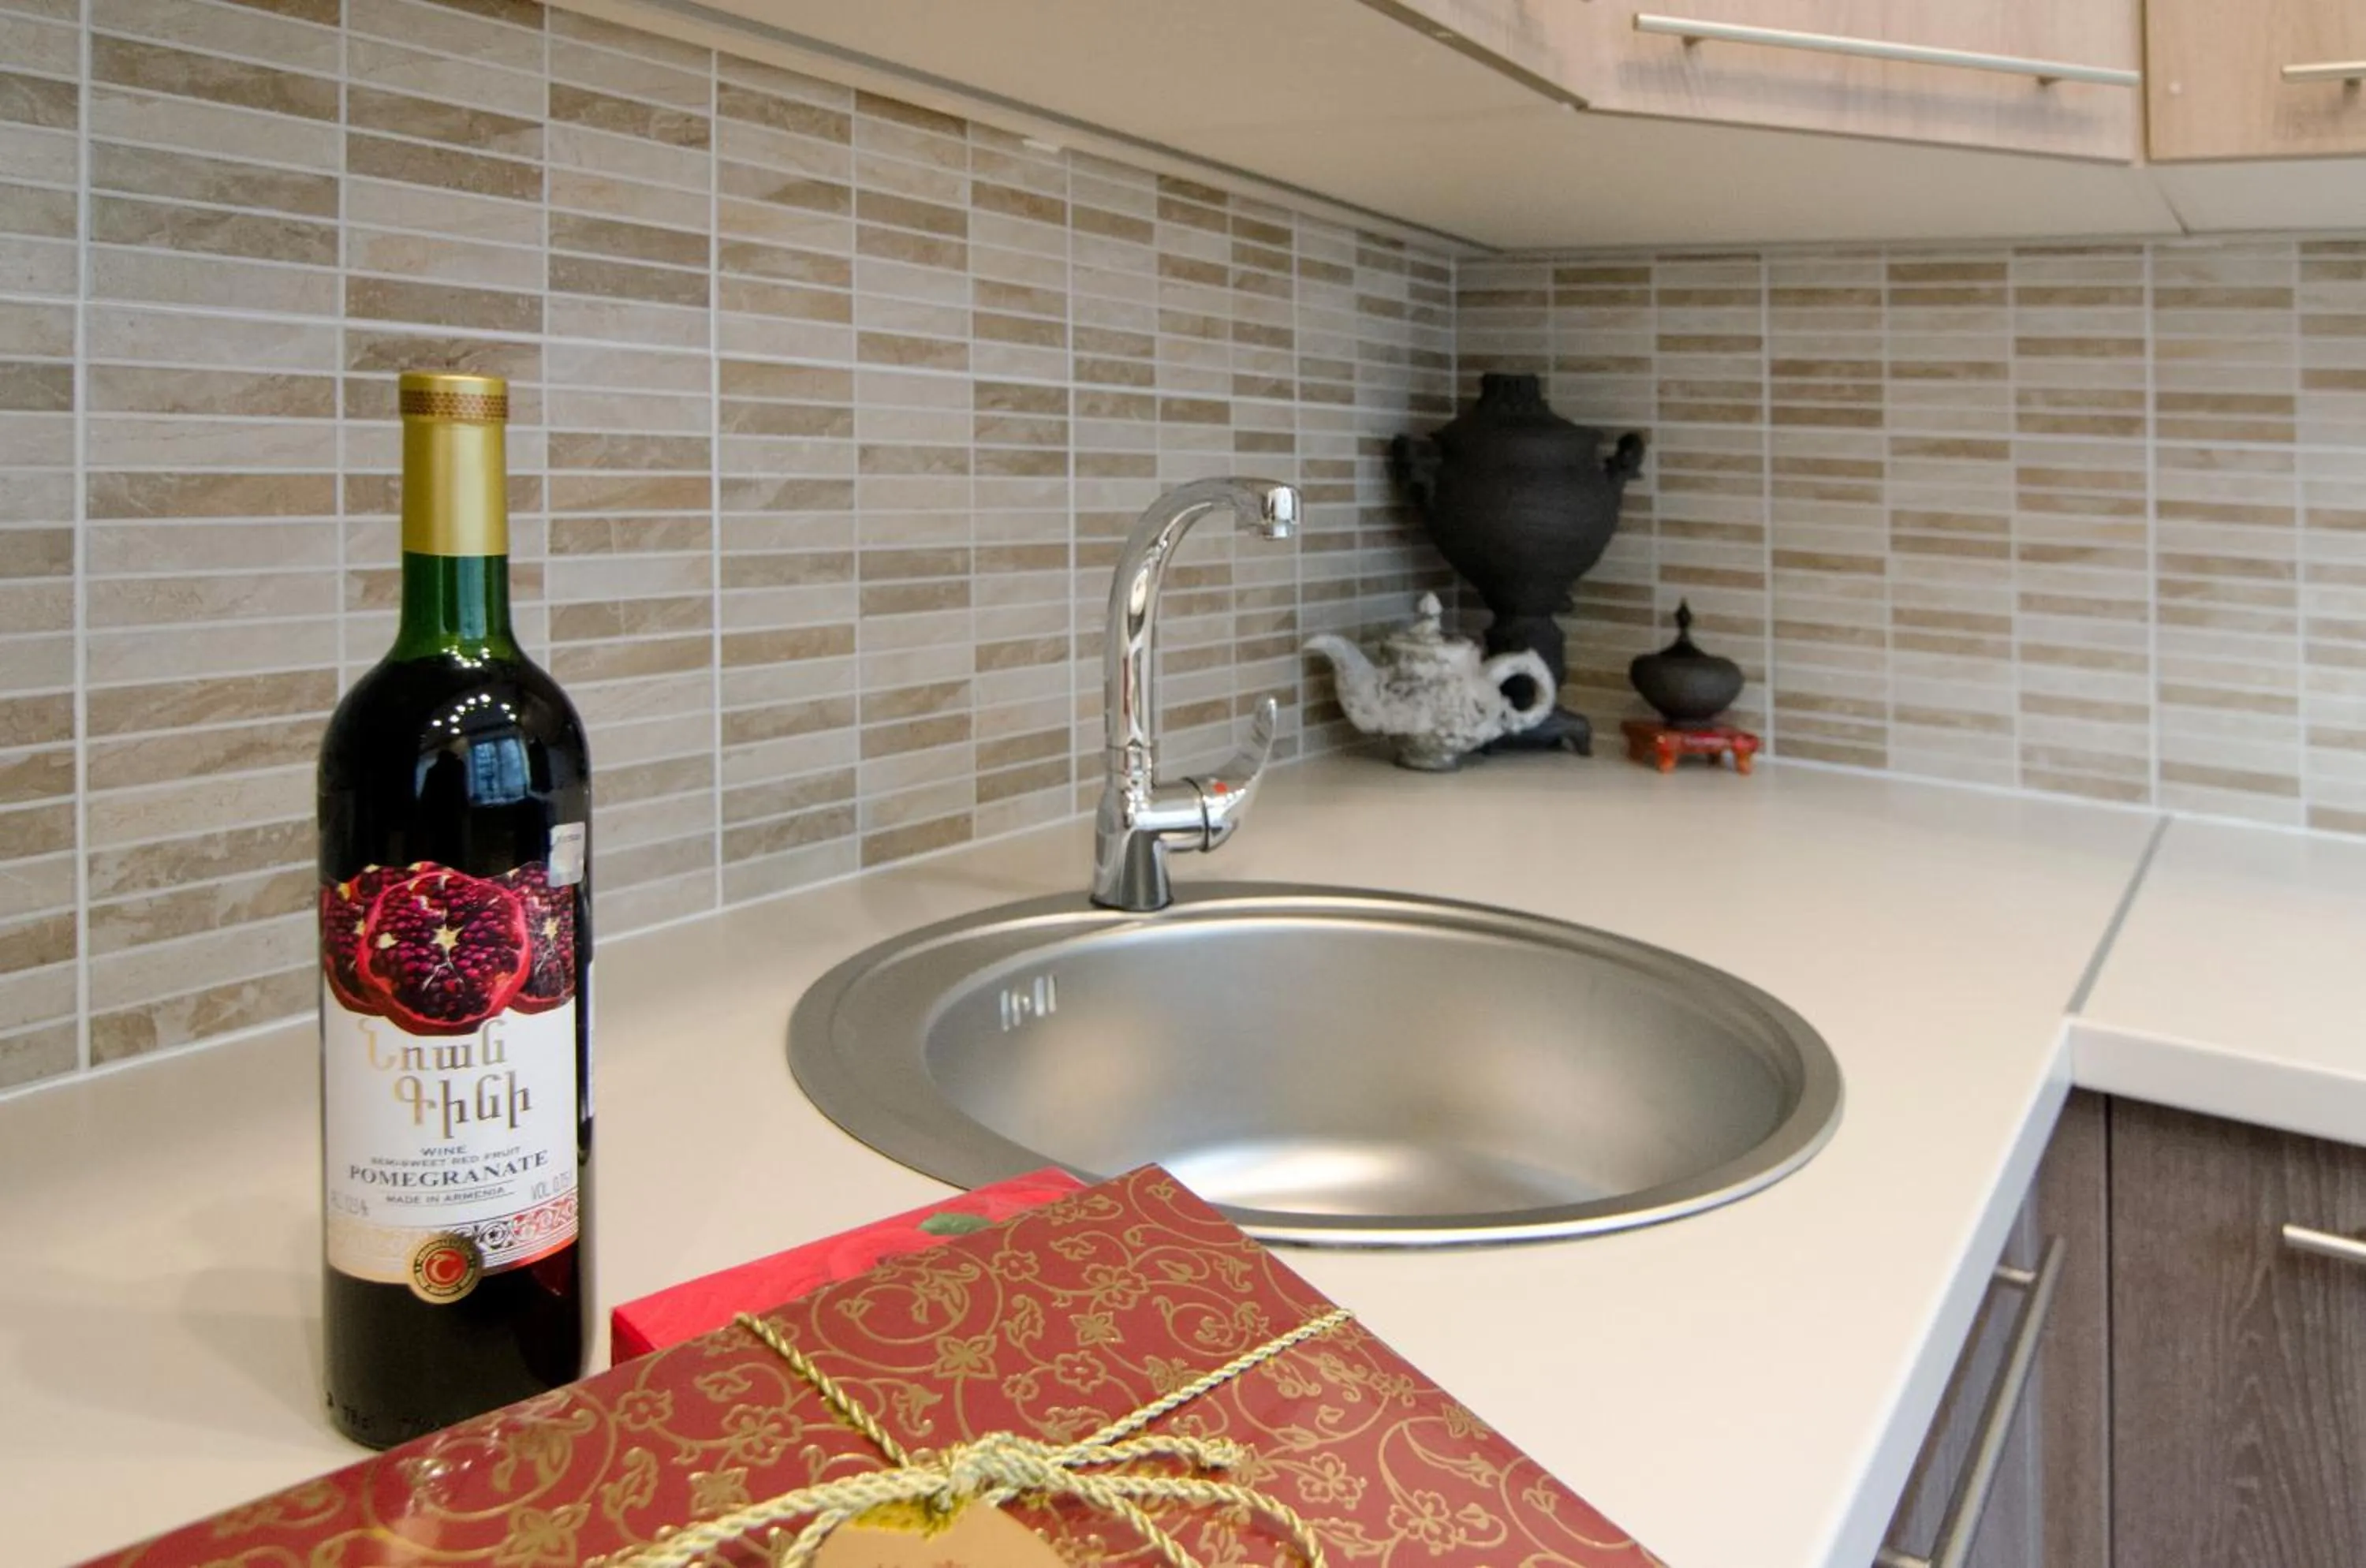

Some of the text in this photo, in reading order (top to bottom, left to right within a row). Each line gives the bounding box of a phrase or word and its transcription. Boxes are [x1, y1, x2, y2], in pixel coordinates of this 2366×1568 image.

[420, 1145, 467, 1156] WINE
[451, 1155, 480, 1165] RED
[484, 1146, 521, 1160] FRUIT
[349, 1150, 550, 1187] POMEGRANATE
[386, 1186, 506, 1204] MADE IN ARMENIA
